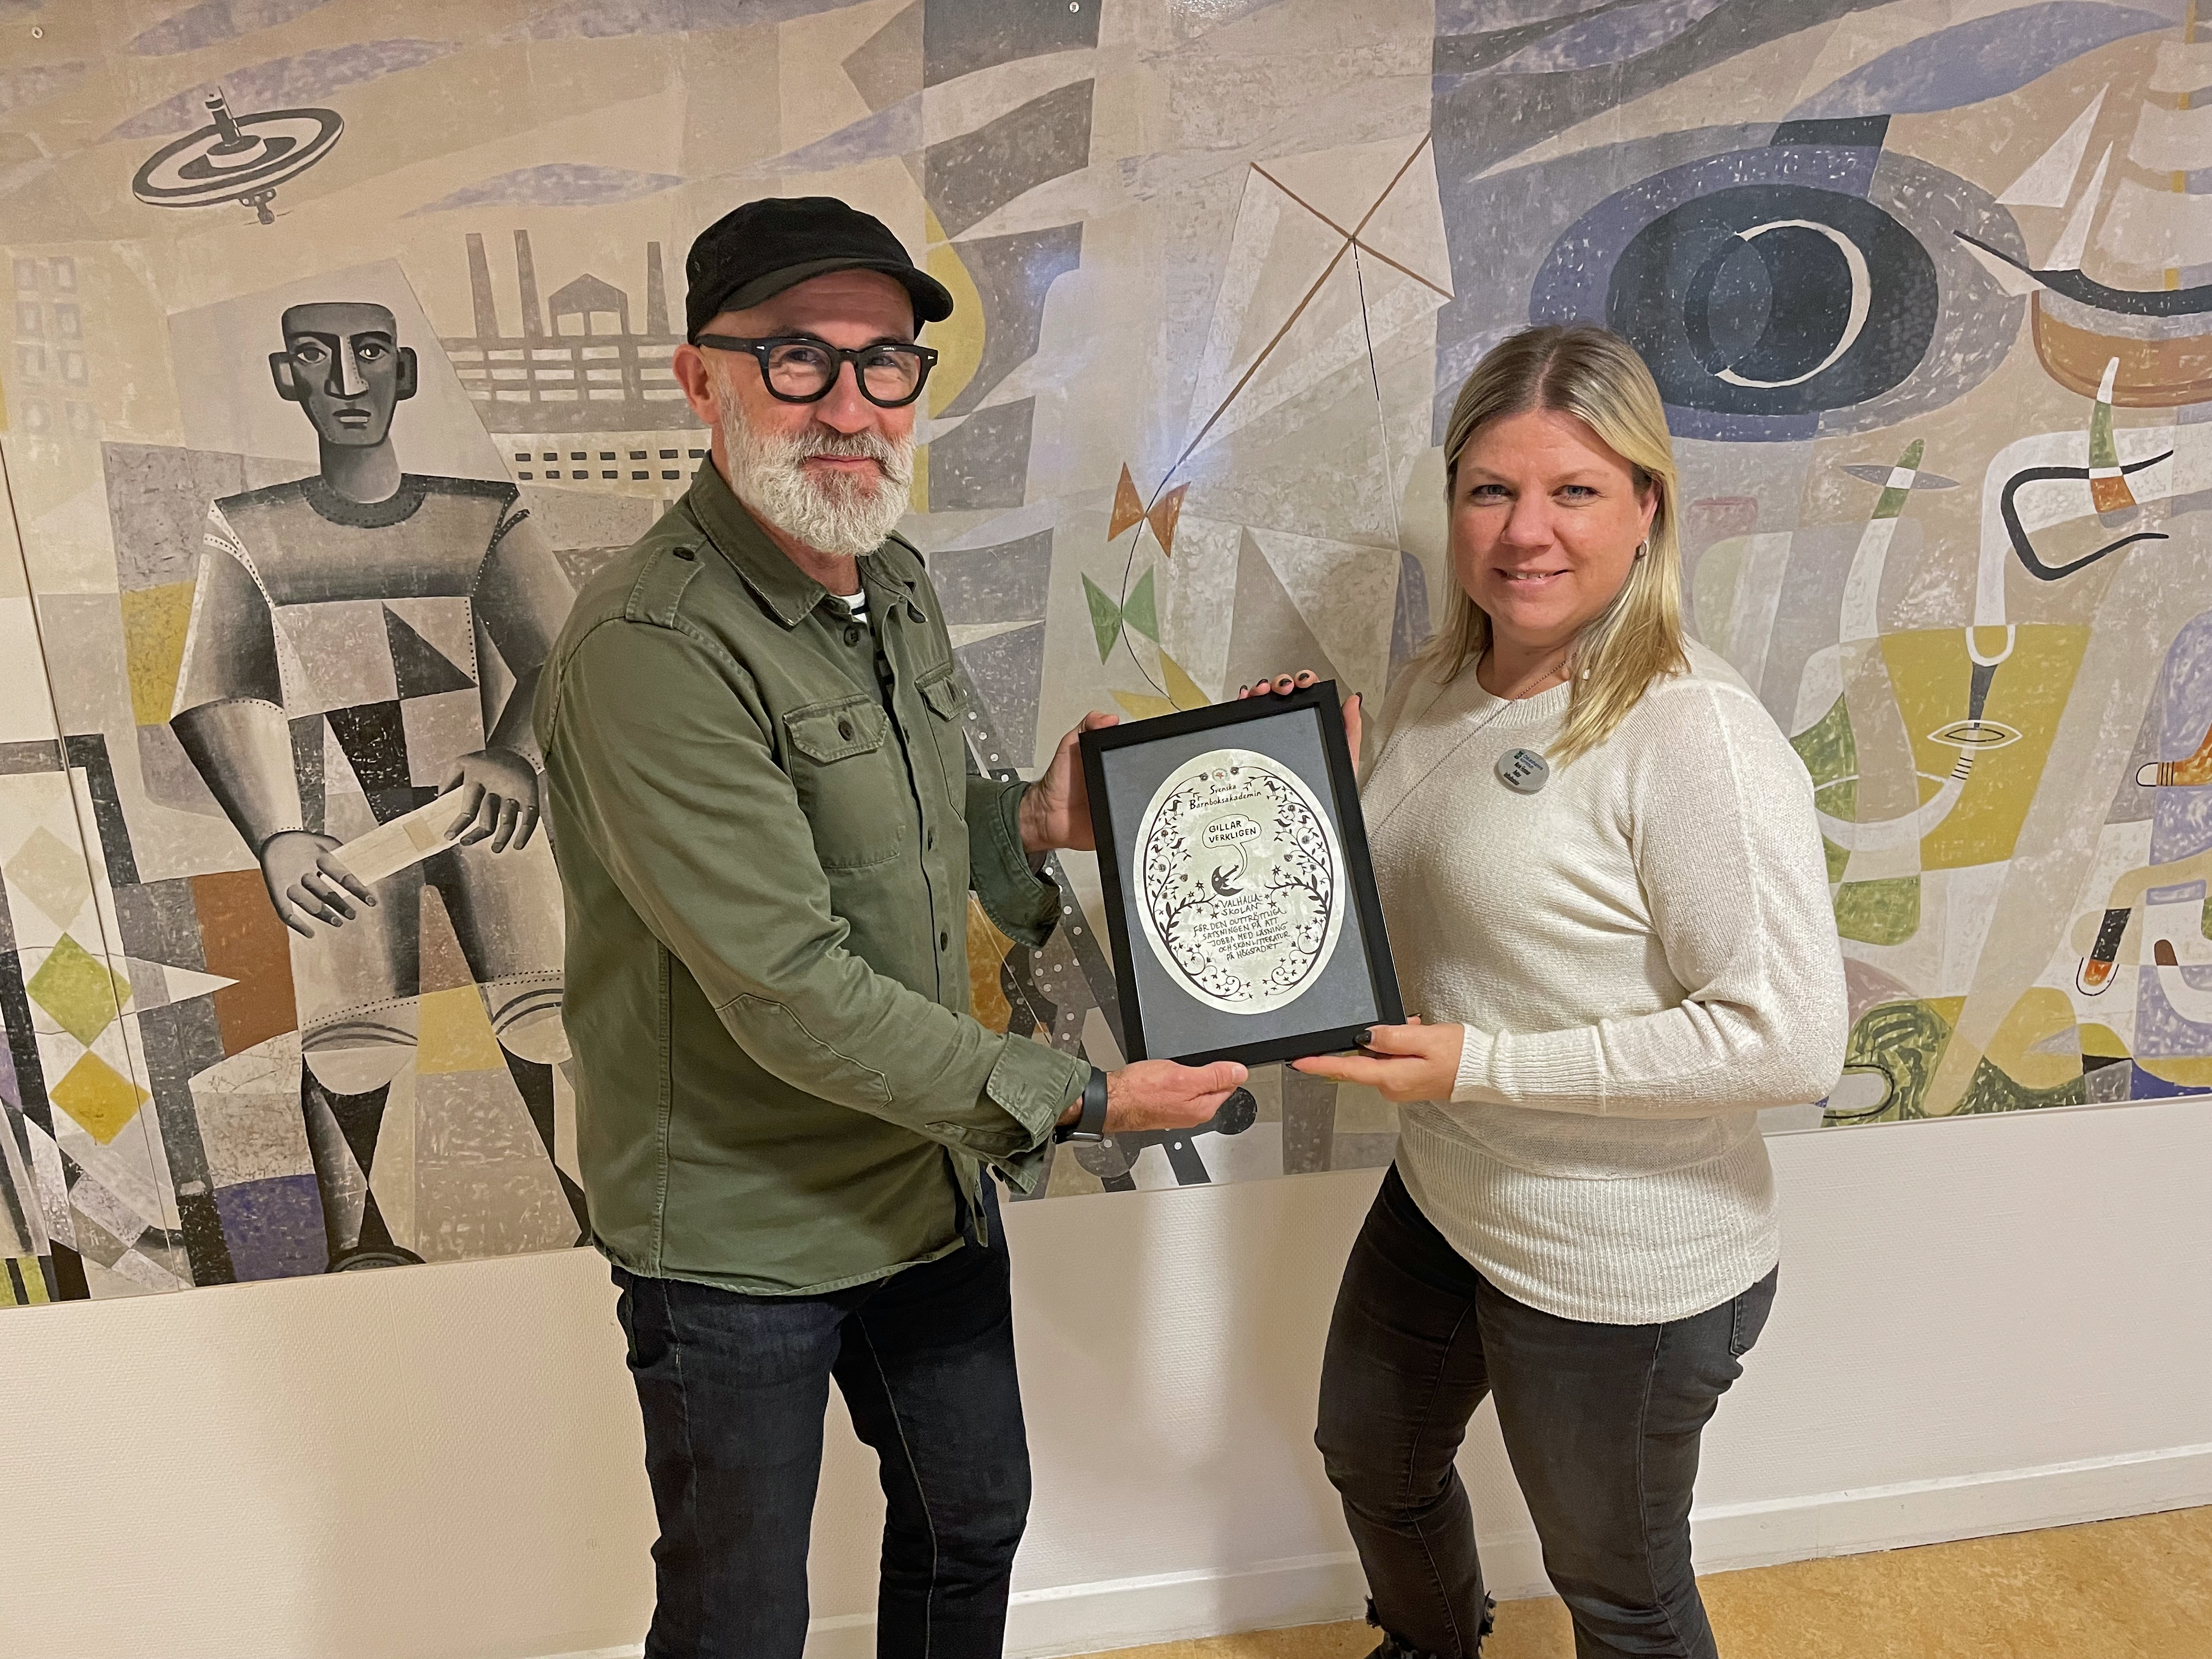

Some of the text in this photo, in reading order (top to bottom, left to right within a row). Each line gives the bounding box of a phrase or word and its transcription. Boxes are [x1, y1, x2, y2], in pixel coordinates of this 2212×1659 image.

[1209, 783, 1237, 794] Svenska
[1189, 790, 1262, 810] Barnboksakademin
[1209, 820, 1242, 833] GILLAR
[1209, 827, 1256, 843] VERKLIGEN
[1221, 902, 1263, 916] SKOLAN
[1210, 921, 1227, 930] DEN
[1229, 907, 1286, 925] OUTTRÖTTLIGA
[1201, 923, 1249, 941] SATSNINGEN
[1265, 917, 1278, 927] ATT
[1207, 936, 1235, 947] JOBBA
[1238, 932, 1253, 940] MED
[1218, 944, 1232, 953] OCH
[1226, 951, 1235, 961] PÅ
